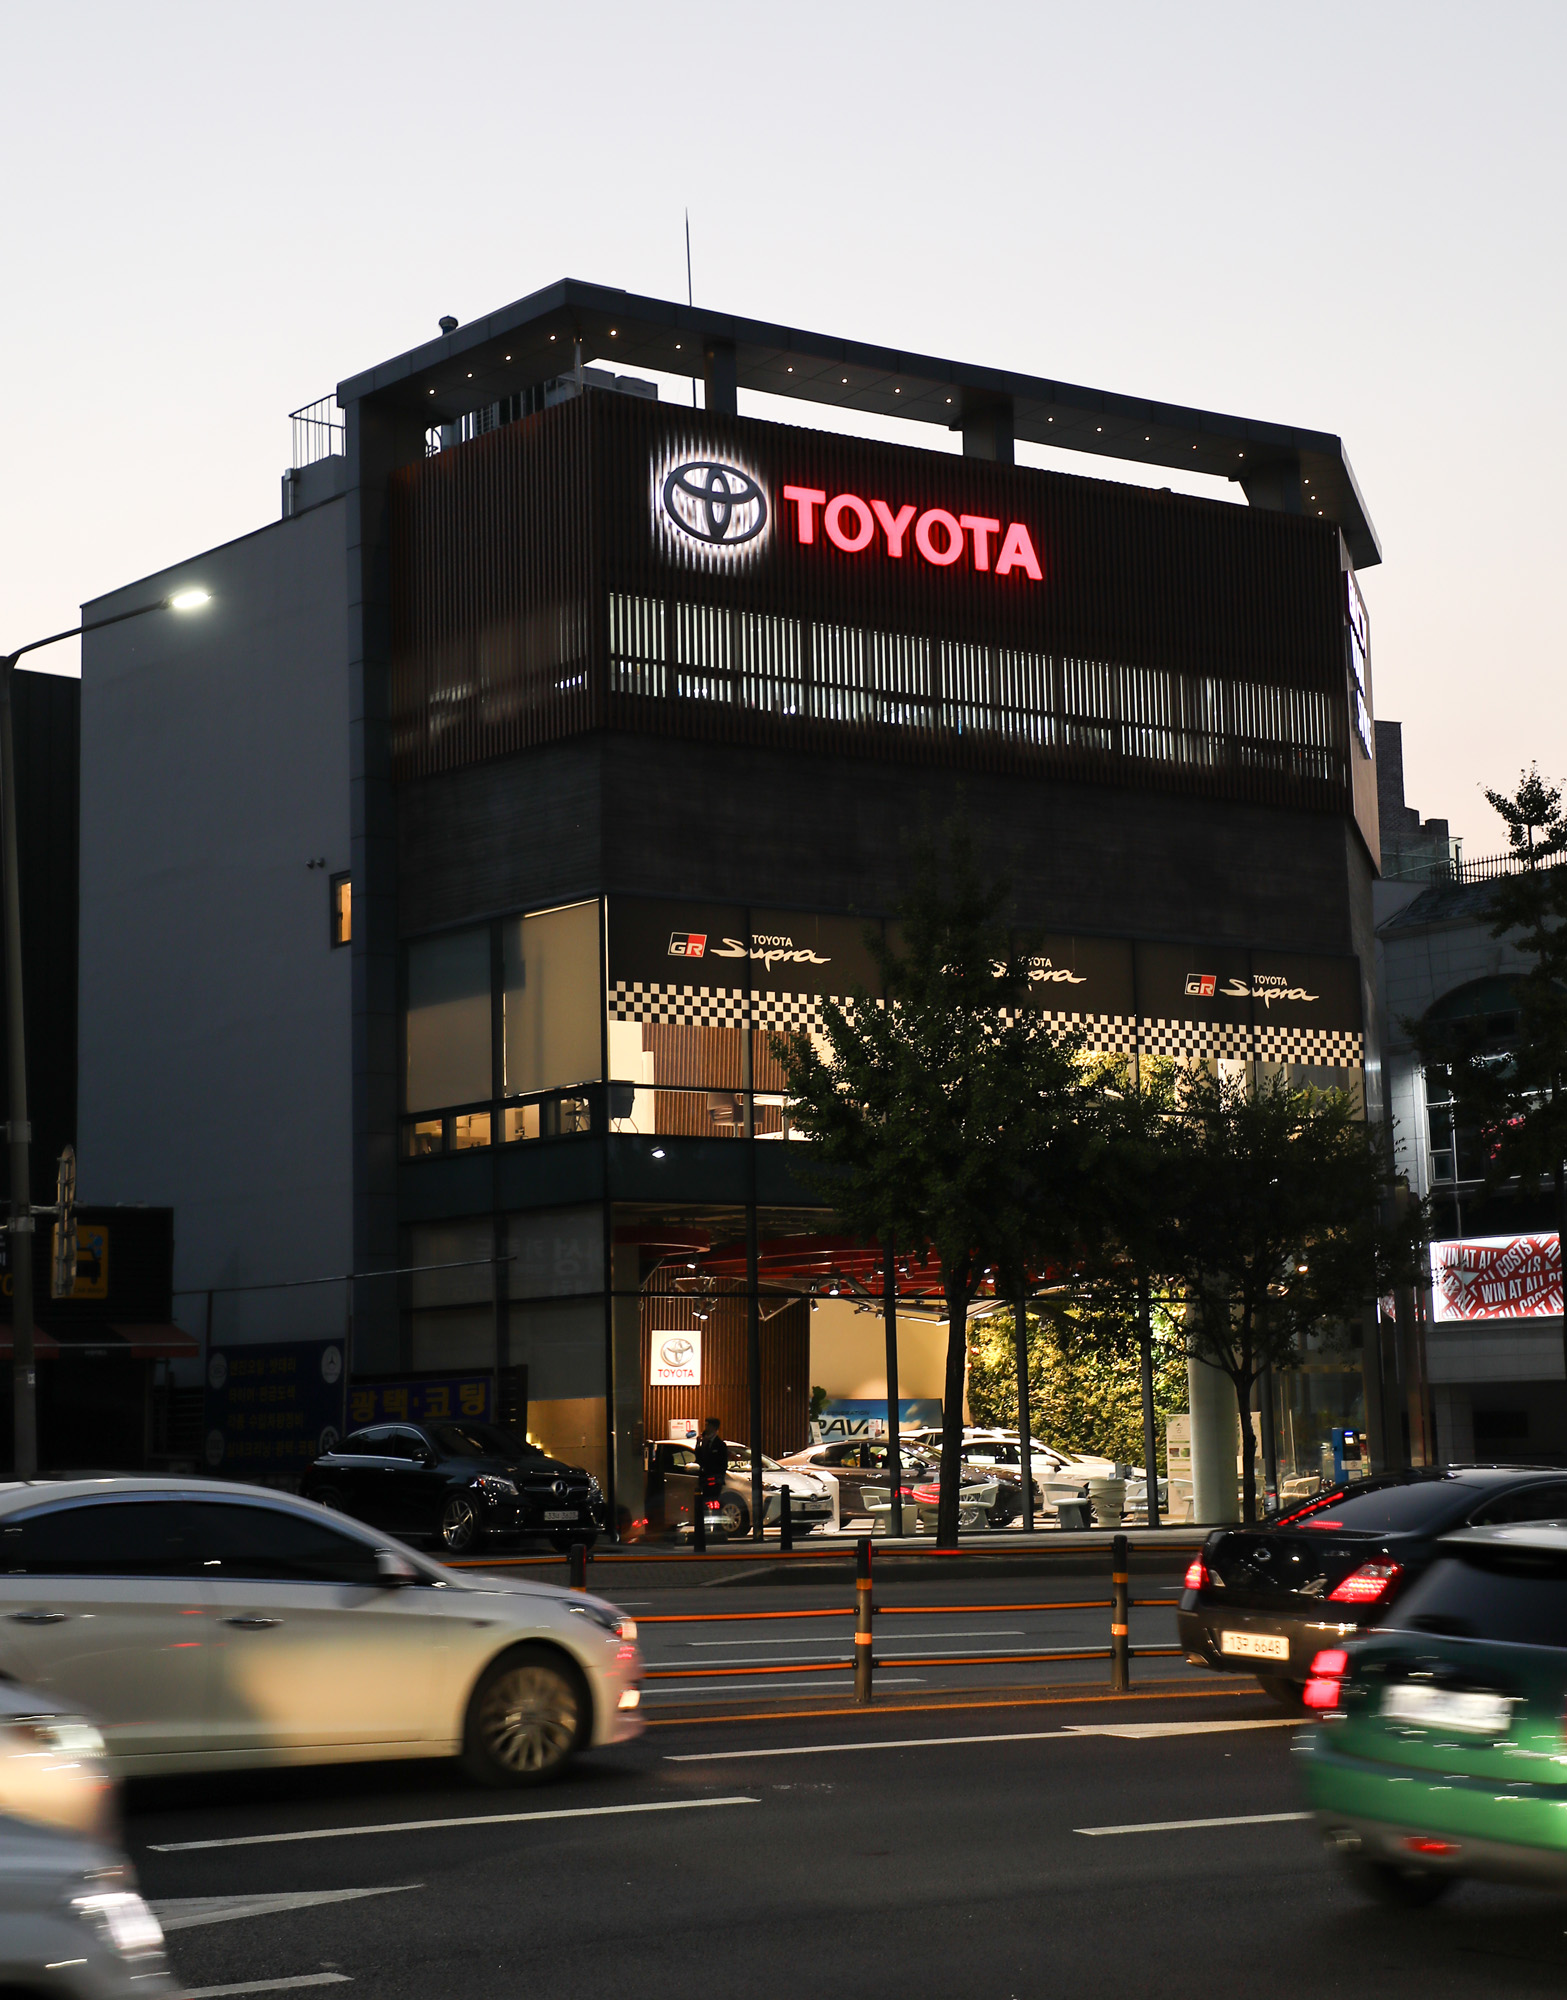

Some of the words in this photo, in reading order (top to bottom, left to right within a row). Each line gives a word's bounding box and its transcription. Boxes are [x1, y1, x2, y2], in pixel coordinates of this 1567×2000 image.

[783, 484, 1044, 581] TOYOTA
[669, 938, 704, 956] GR
[751, 934, 794, 947] TOYOTA
[710, 937, 832, 972] Supra
[1186, 978, 1215, 995] GR
[1253, 974, 1288, 987] TOYOTA
[1219, 978, 1320, 1009] Supra
[1462, 1249, 1476, 1268] AT
[1495, 1237, 1533, 1278] COSTS
[1481, 1282, 1507, 1304] WIN
[1509, 1279, 1522, 1300] AT
[658, 1369, 695, 1378] TOYOTA
[1254, 1638, 1282, 1655] 6648
